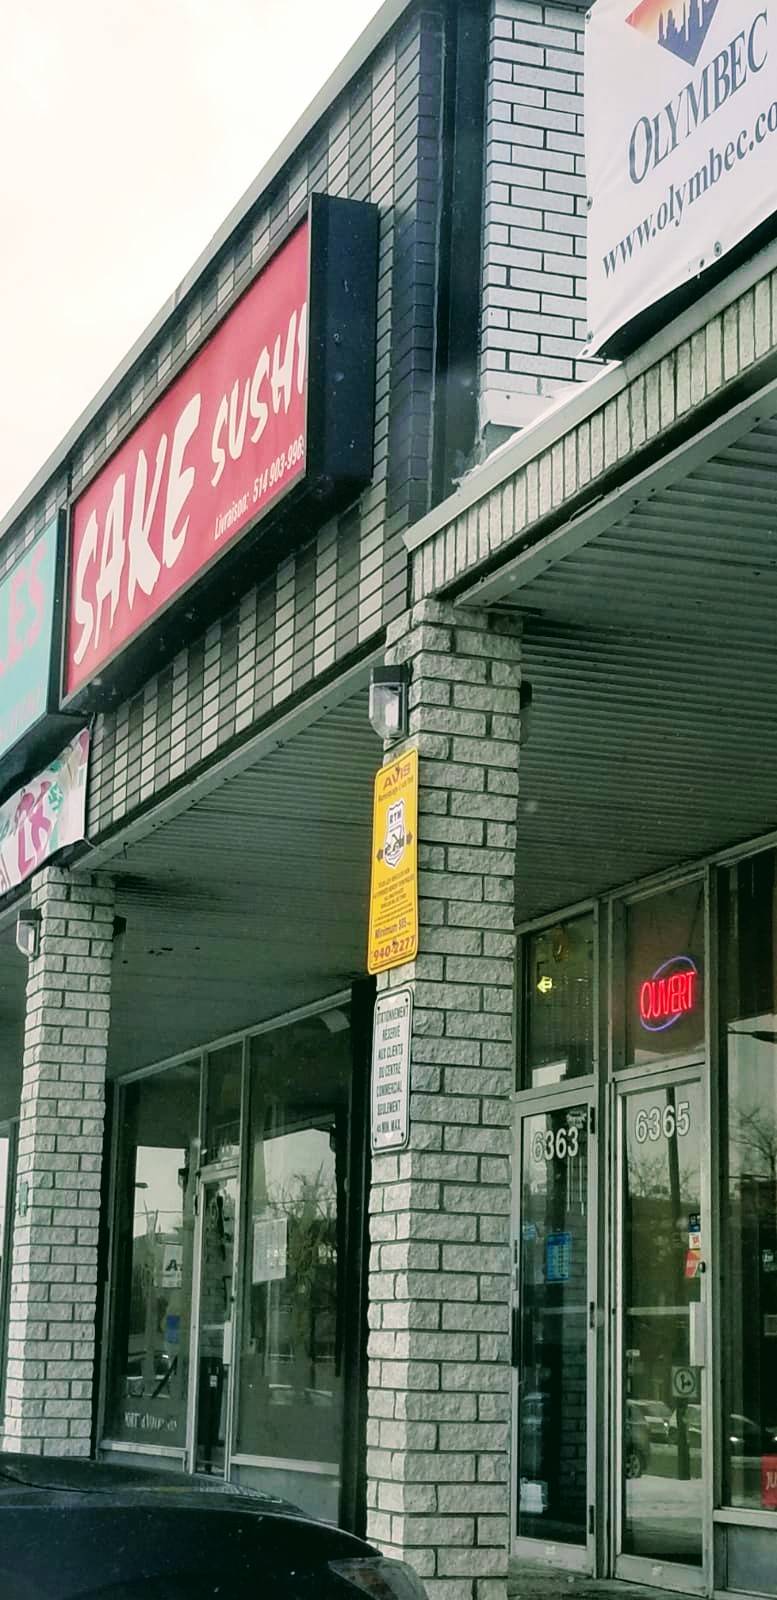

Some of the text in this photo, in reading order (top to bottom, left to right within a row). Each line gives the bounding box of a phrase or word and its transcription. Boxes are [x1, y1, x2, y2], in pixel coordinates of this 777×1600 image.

[628, 9, 768, 185] OLYMBEC
[73, 301, 306, 665] SAKE SUSHI
[253, 468, 269, 503] 514
[383, 762, 411, 791] AVIS
[373, 935, 417, 962] 940-2277
[640, 971, 697, 1019] OUVERT
[635, 1102, 691, 1144] 6365
[531, 1126, 580, 1162] 6363
